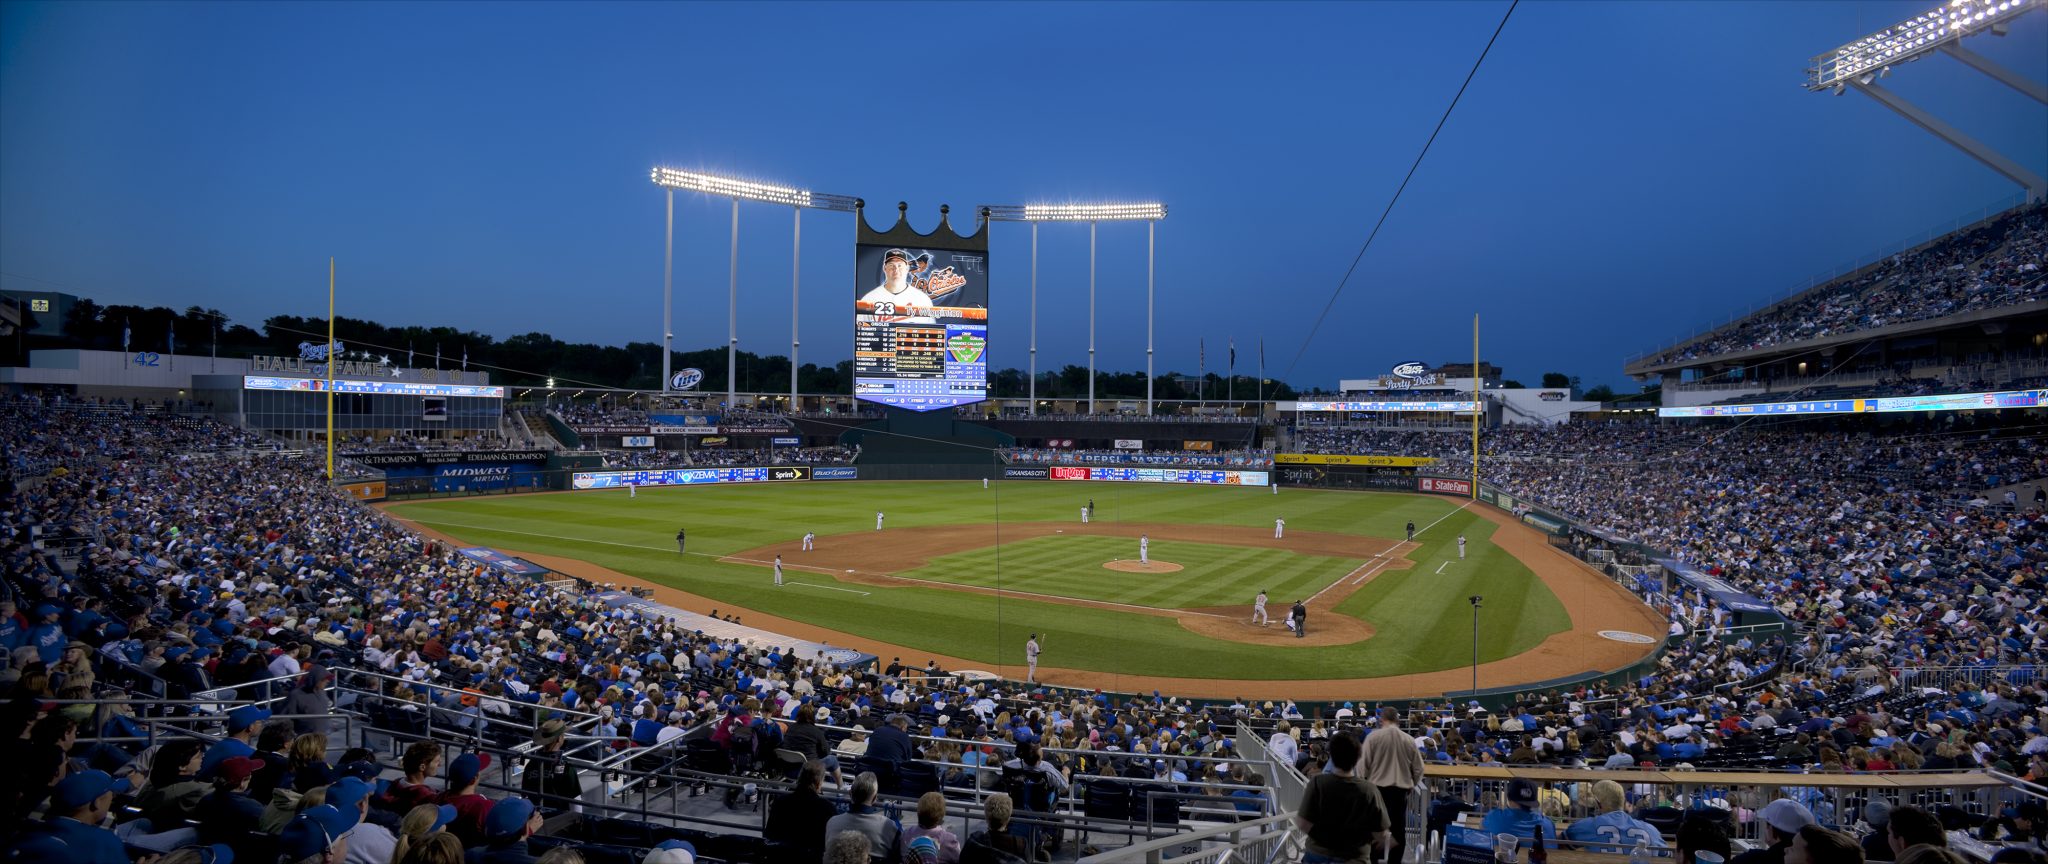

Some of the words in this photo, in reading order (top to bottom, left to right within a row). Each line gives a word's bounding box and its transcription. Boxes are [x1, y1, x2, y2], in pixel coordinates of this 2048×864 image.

[875, 301, 895, 315] 23
[919, 308, 963, 318] Wigginton
[134, 352, 160, 367] 42
[253, 355, 310, 373] HALL
[333, 359, 386, 378] FAME
[420, 368, 437, 380] 20
[448, 369, 463, 381] 10
[479, 371, 488, 383] 5
[1385, 379, 1412, 391] Party
[1413, 376, 1437, 386] Deck
[374, 455, 417, 464] THOMPSON
[467, 453, 498, 464] EDELMAN
[500, 452, 509, 463] &
[509, 452, 546, 463] THOMPSON
[1086, 455, 1121, 463] PEPSI
[1367, 457, 1386, 465] Sprint
[441, 466, 510, 477] MIDWEST
[677, 470, 718, 484] NOXZEMA
[775, 471, 794, 479] Sprint
[830, 469, 855, 477] LIGHT
[1284, 469, 1313, 481] Sprint
[471, 474, 511, 483] AIRLINES
